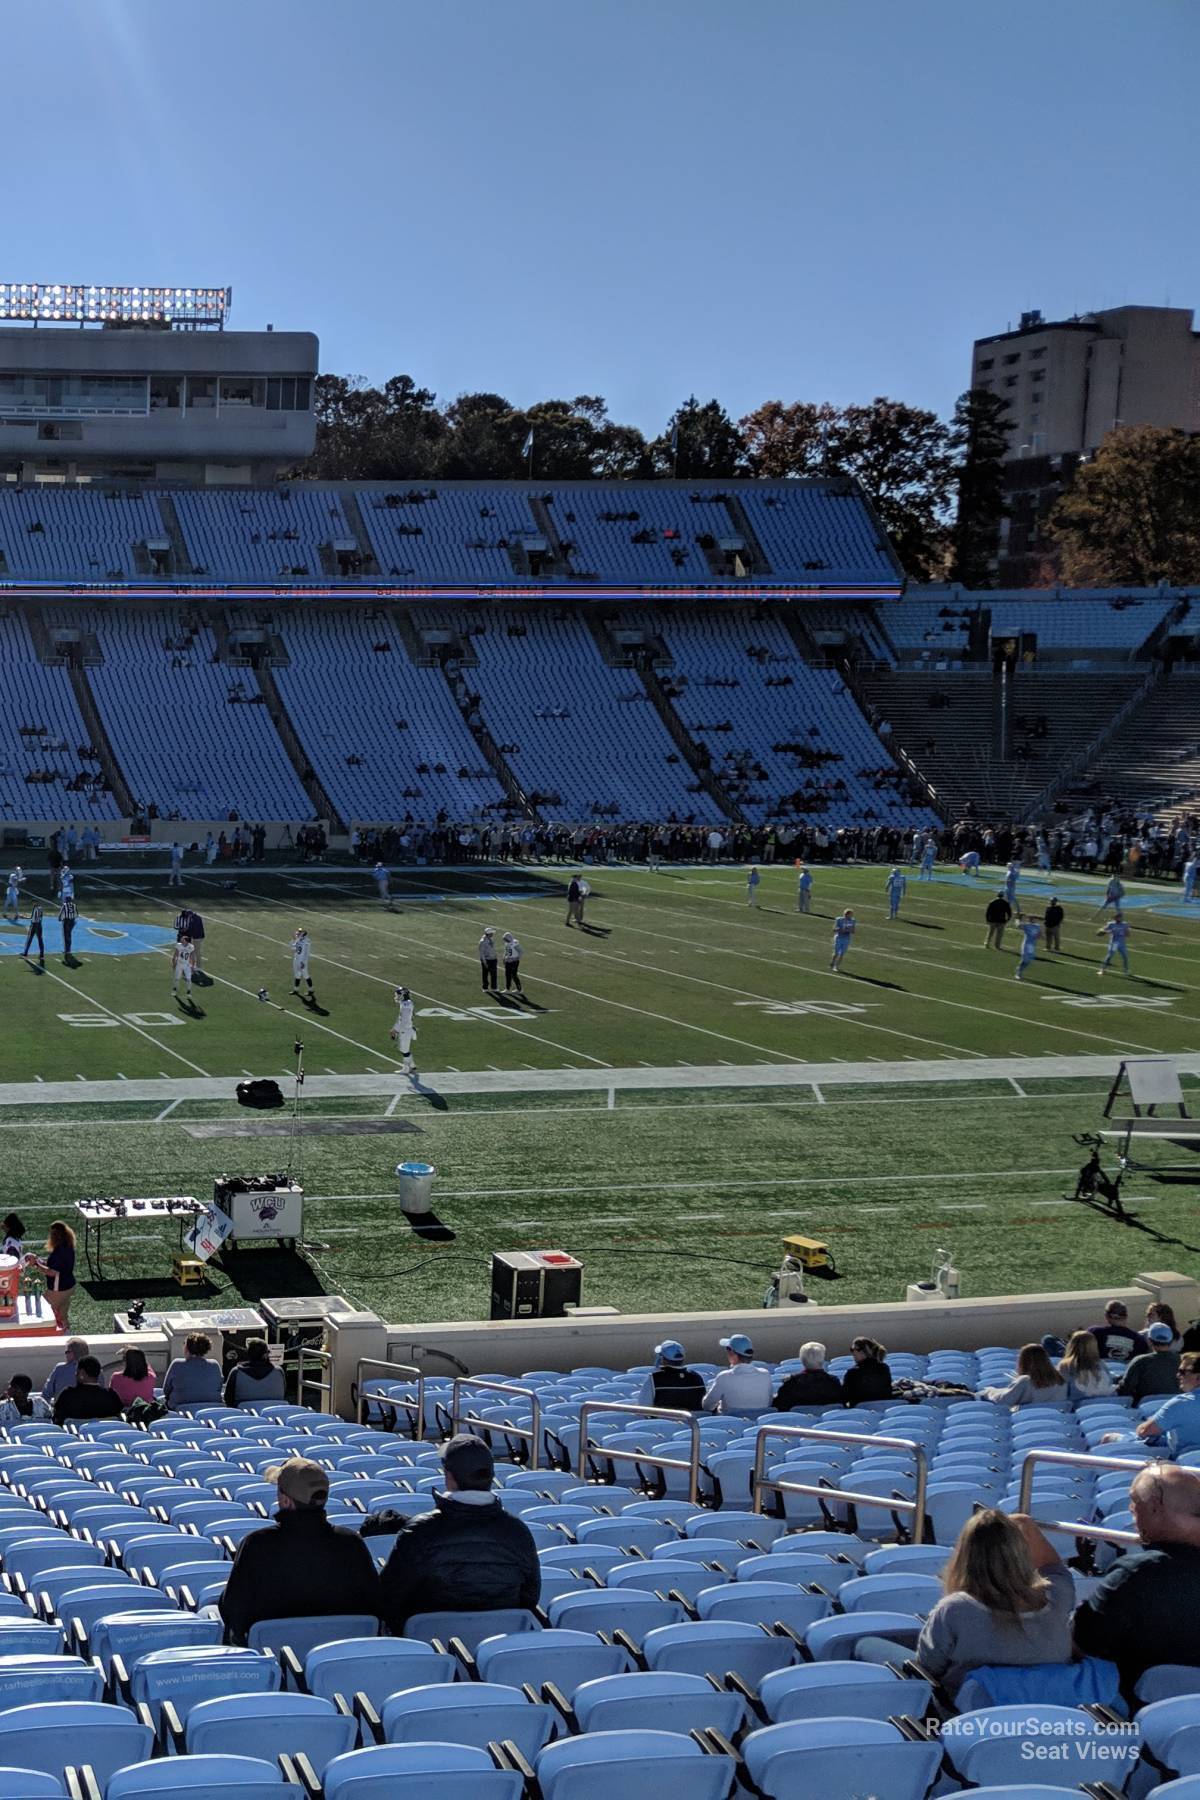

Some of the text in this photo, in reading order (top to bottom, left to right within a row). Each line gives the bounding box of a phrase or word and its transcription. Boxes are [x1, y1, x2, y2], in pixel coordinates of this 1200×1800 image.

[56, 1011, 187, 1028] 50
[414, 1006, 539, 1021] 40
[249, 1195, 286, 1213] WCU
